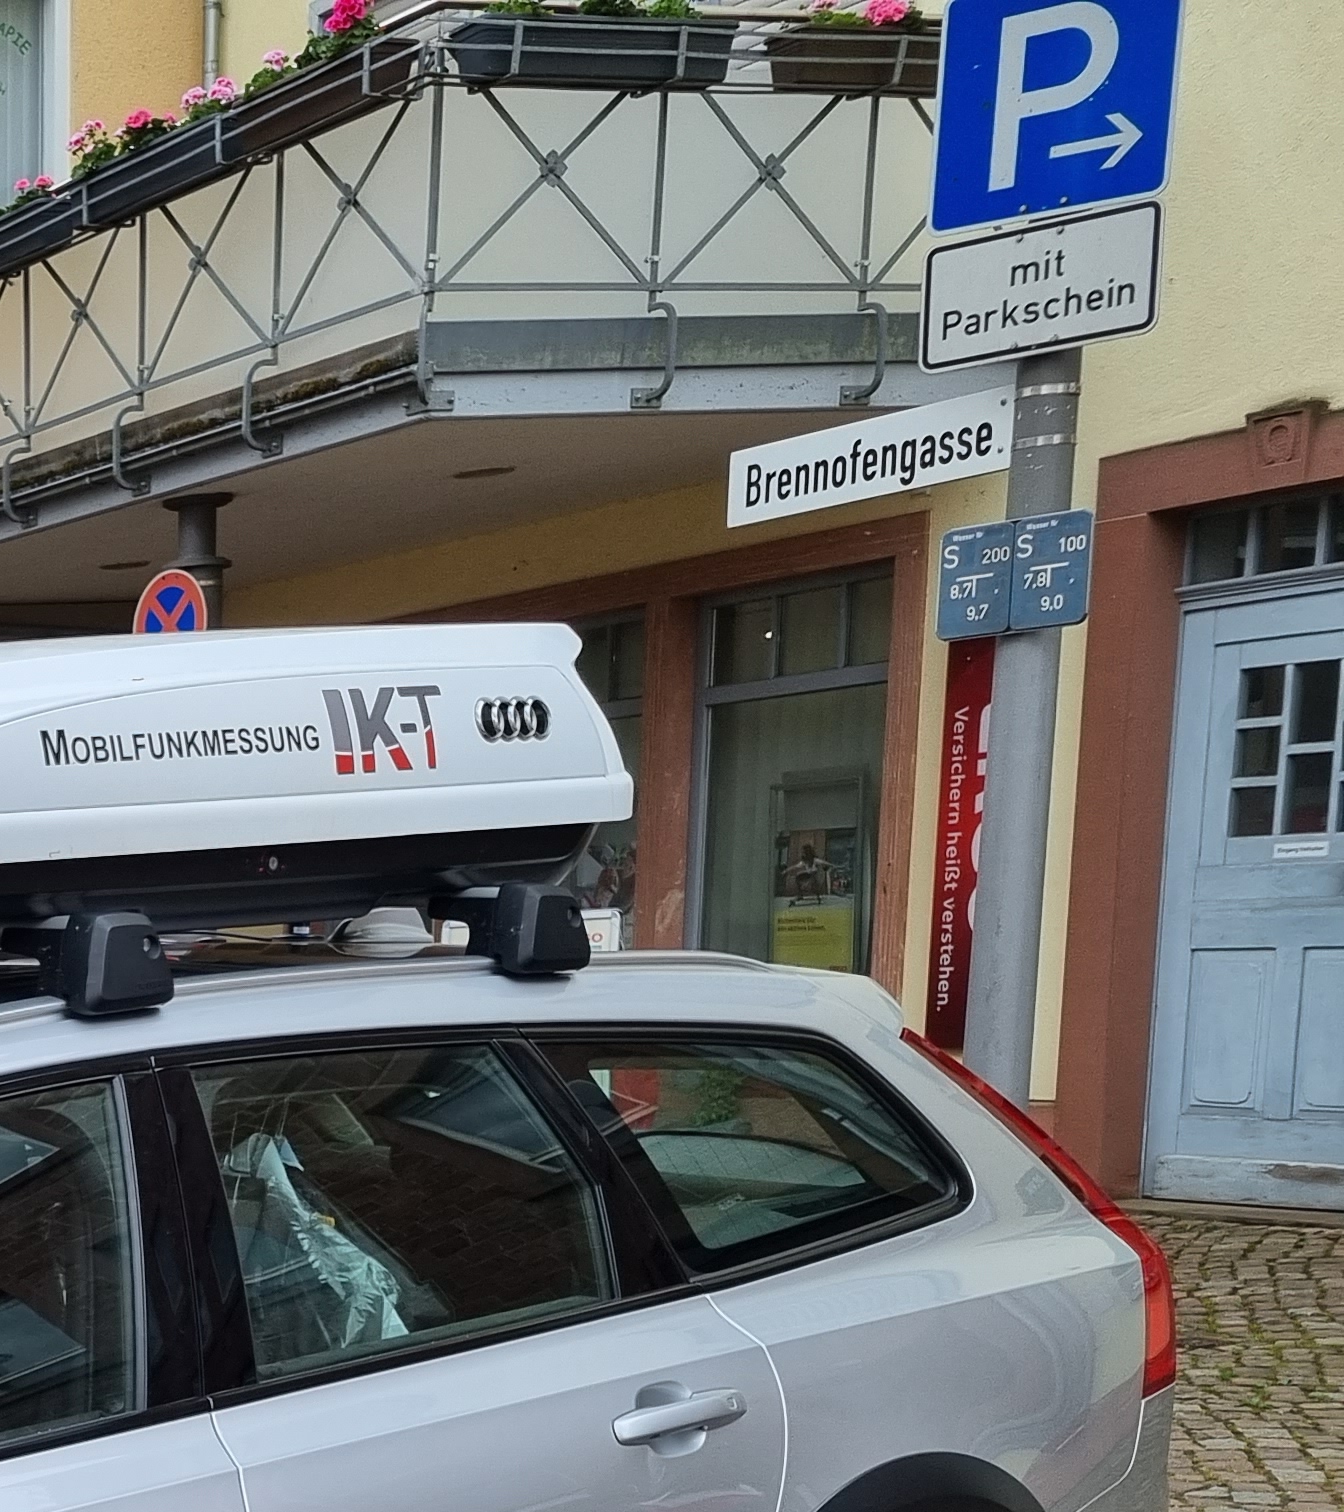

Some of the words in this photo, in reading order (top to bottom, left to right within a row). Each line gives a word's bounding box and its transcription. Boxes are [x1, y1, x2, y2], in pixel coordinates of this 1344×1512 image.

[988, 1, 1120, 193] P
[1010, 251, 1065, 289] mit
[941, 279, 1136, 341] Parkschein
[745, 421, 993, 508] Brennofengasse
[943, 545, 960, 569] S
[981, 546, 1010, 565] 200
[1016, 534, 1033, 558] S
[1059, 534, 1086, 553] 100
[946, 706, 969, 826] Versichern
[944, 830, 961, 892] heißt
